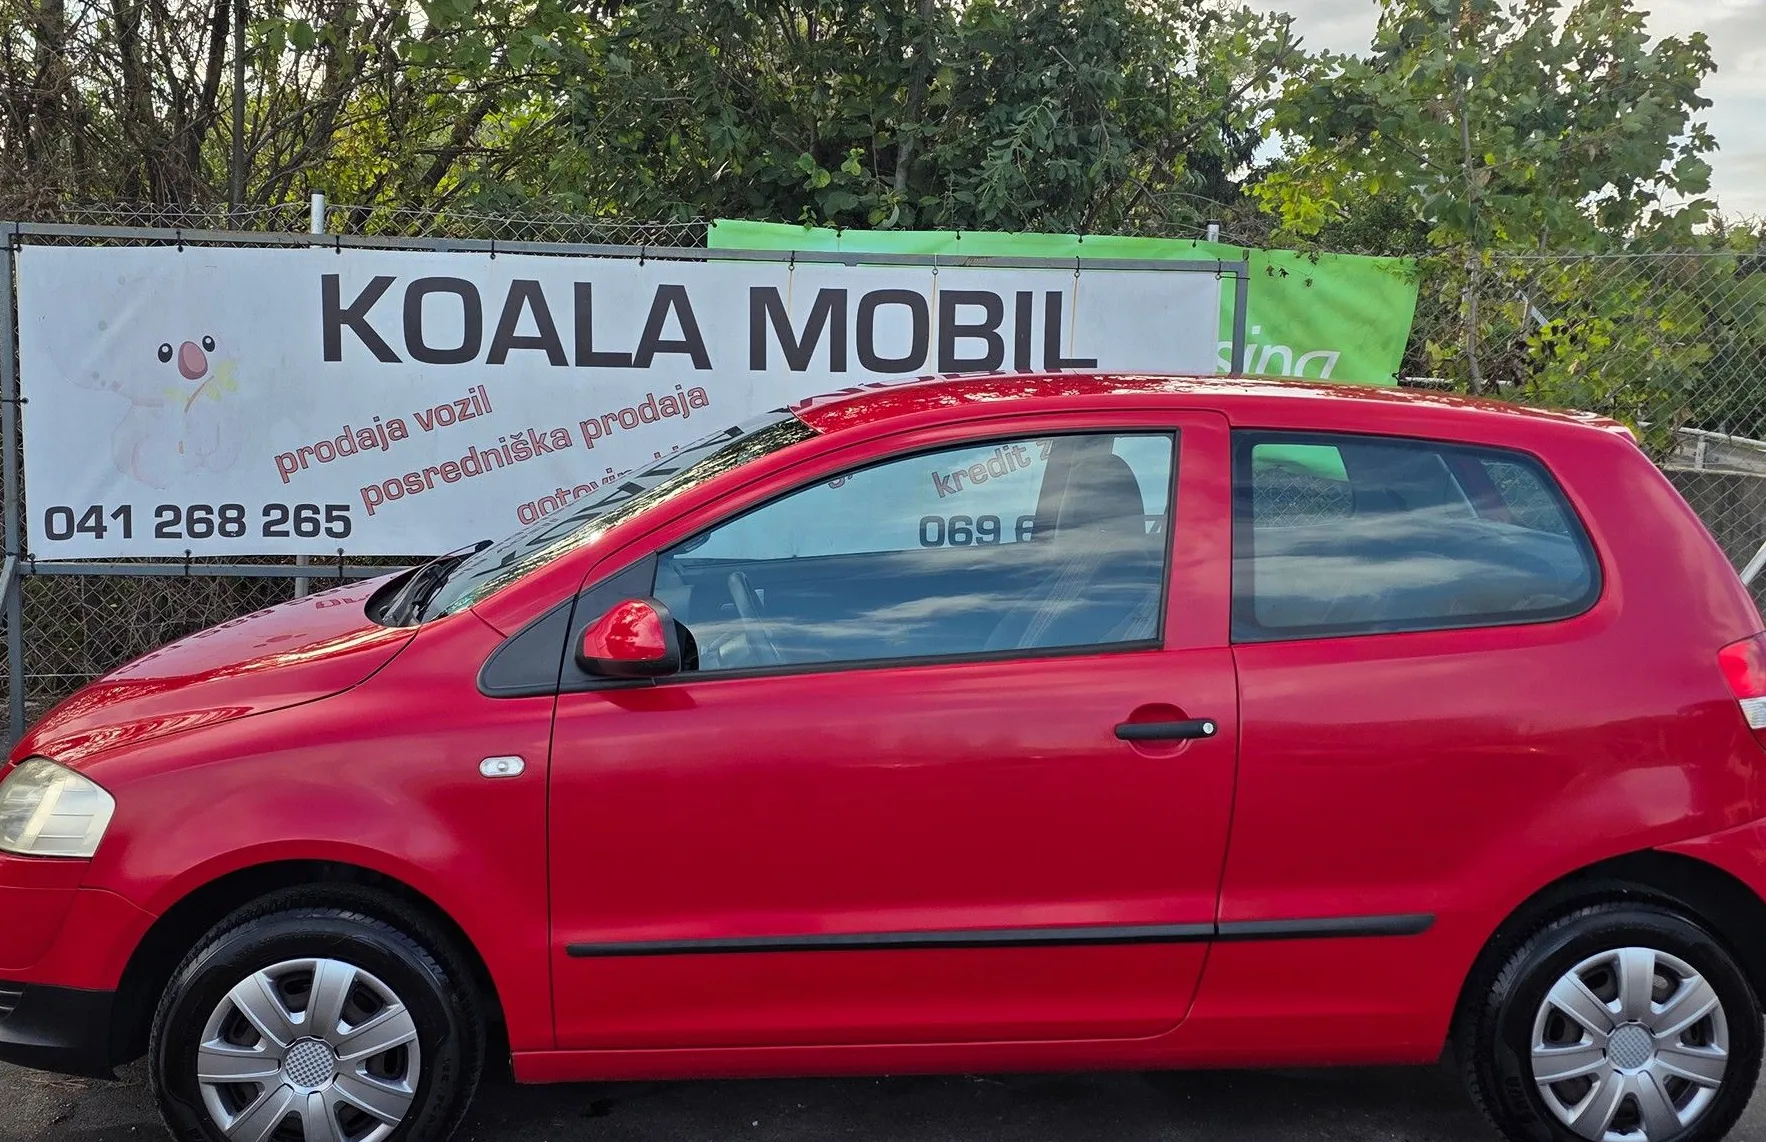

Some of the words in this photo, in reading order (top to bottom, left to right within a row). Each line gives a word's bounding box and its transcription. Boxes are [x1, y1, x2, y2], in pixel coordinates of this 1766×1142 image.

[321, 274, 713, 370] KOALA
[750, 286, 1098, 374] MOBIL
[274, 416, 409, 483] prodaja
[413, 385, 493, 432] vozil
[359, 428, 572, 516] posredniška
[579, 384, 710, 449] prodaja
[931, 444, 1031, 498] kredit
[44, 504, 132, 541] 041
[154, 503, 247, 539] 268
[262, 503, 352, 539] 265
[918, 514, 1001, 547] 069
